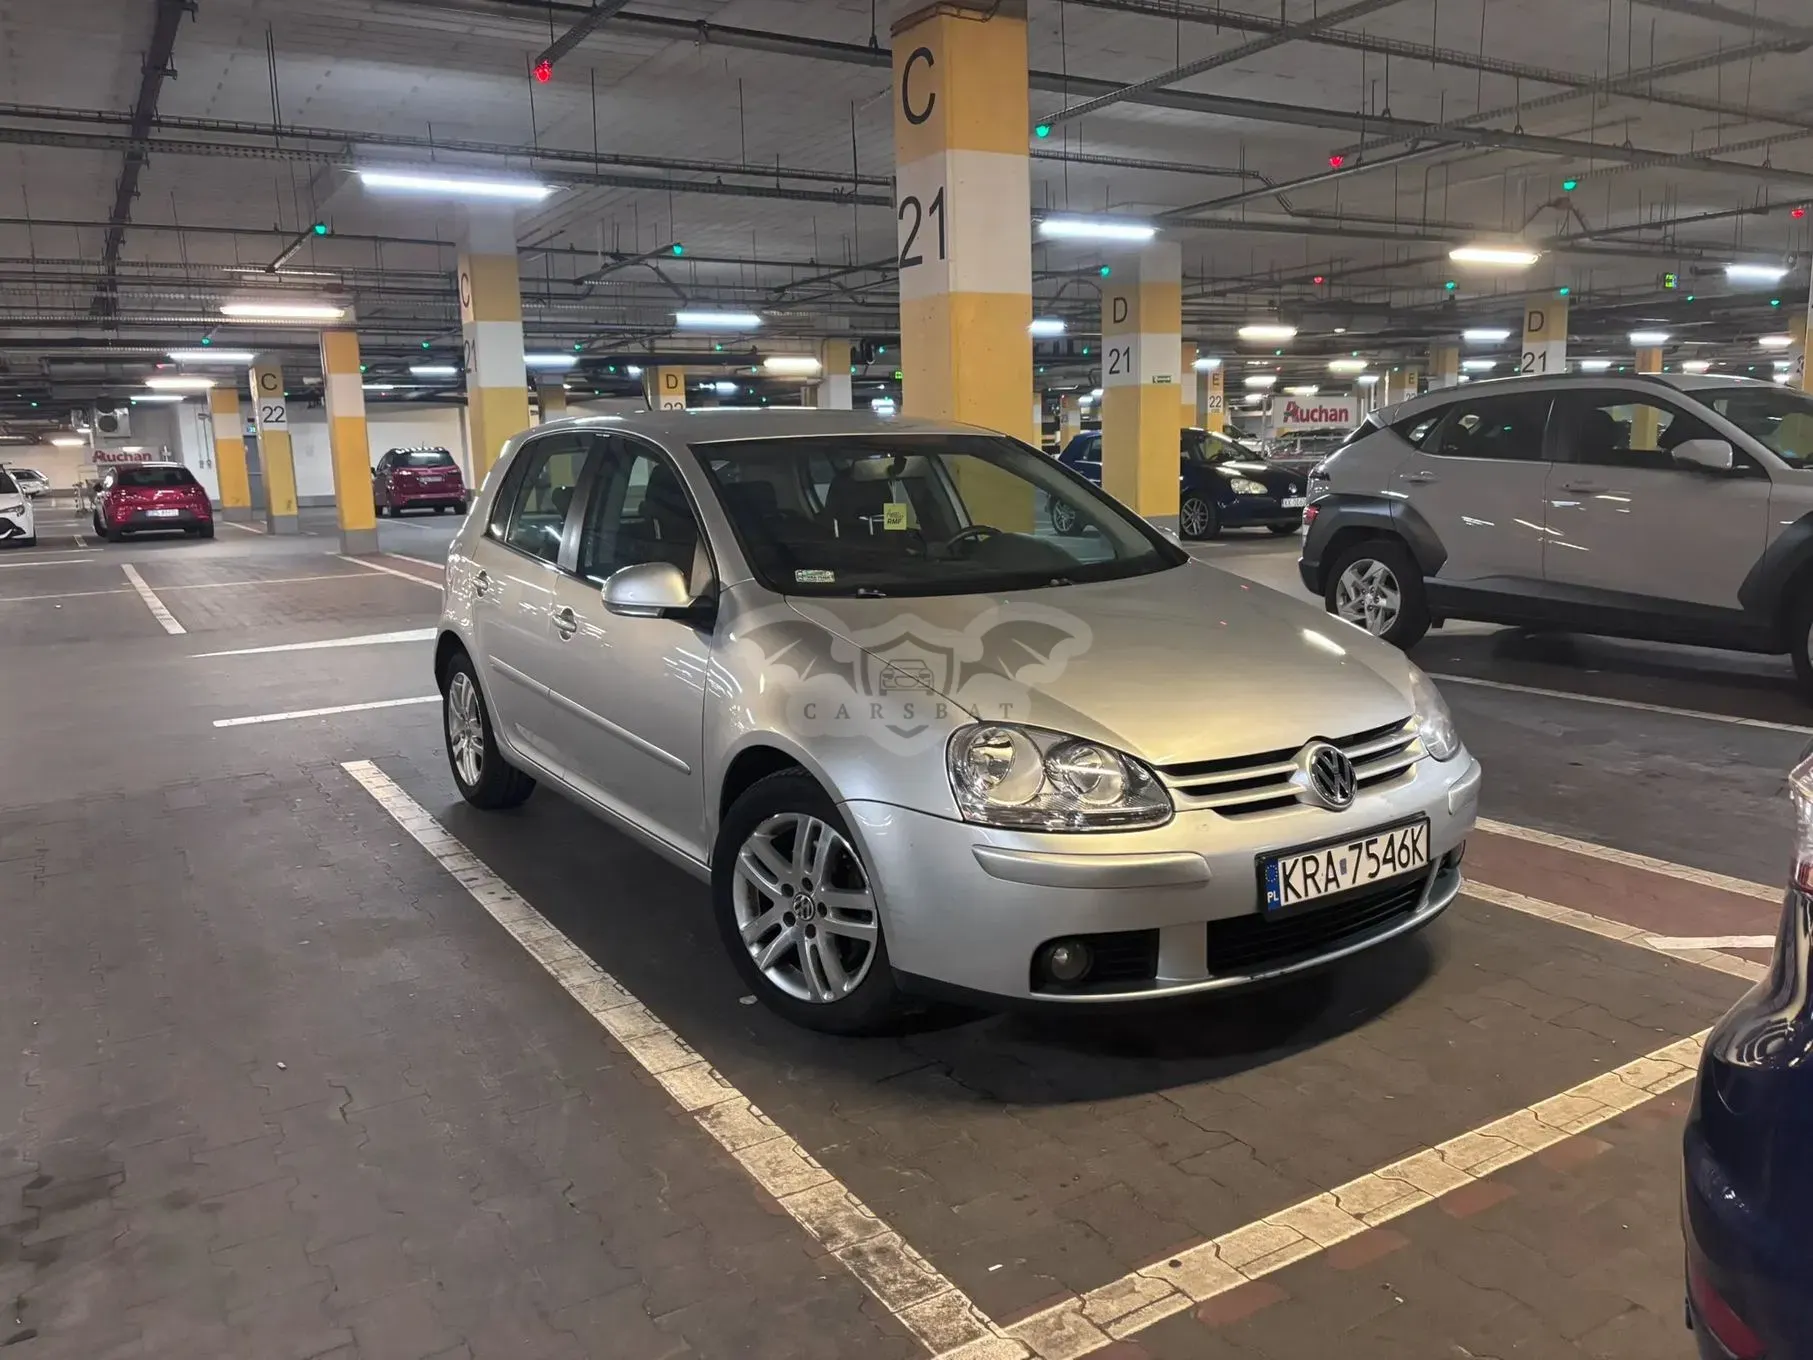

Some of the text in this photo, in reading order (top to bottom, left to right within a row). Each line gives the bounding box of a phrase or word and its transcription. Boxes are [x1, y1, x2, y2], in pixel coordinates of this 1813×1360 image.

[902, 47, 936, 125] C
[898, 186, 945, 269] 21
[461, 272, 470, 308] C
[1113, 296, 1128, 324] D
[1528, 310, 1545, 332] D
[464, 339, 478, 373] 21
[1108, 345, 1131, 375] 21
[1521, 350, 1547, 373] 21
[261, 372, 278, 391] C
[665, 373, 679, 390] D
[1212, 372, 1220, 386] E
[1408, 372, 1415, 385] E
[1209, 395, 1222, 409] 22
[1283, 400, 1349, 423] Auchan
[262, 405, 286, 423] 22
[92, 450, 152, 462] Auchan
[1280, 824, 1425, 903] KRA 7546K
[1267, 890, 1280, 904] PL
